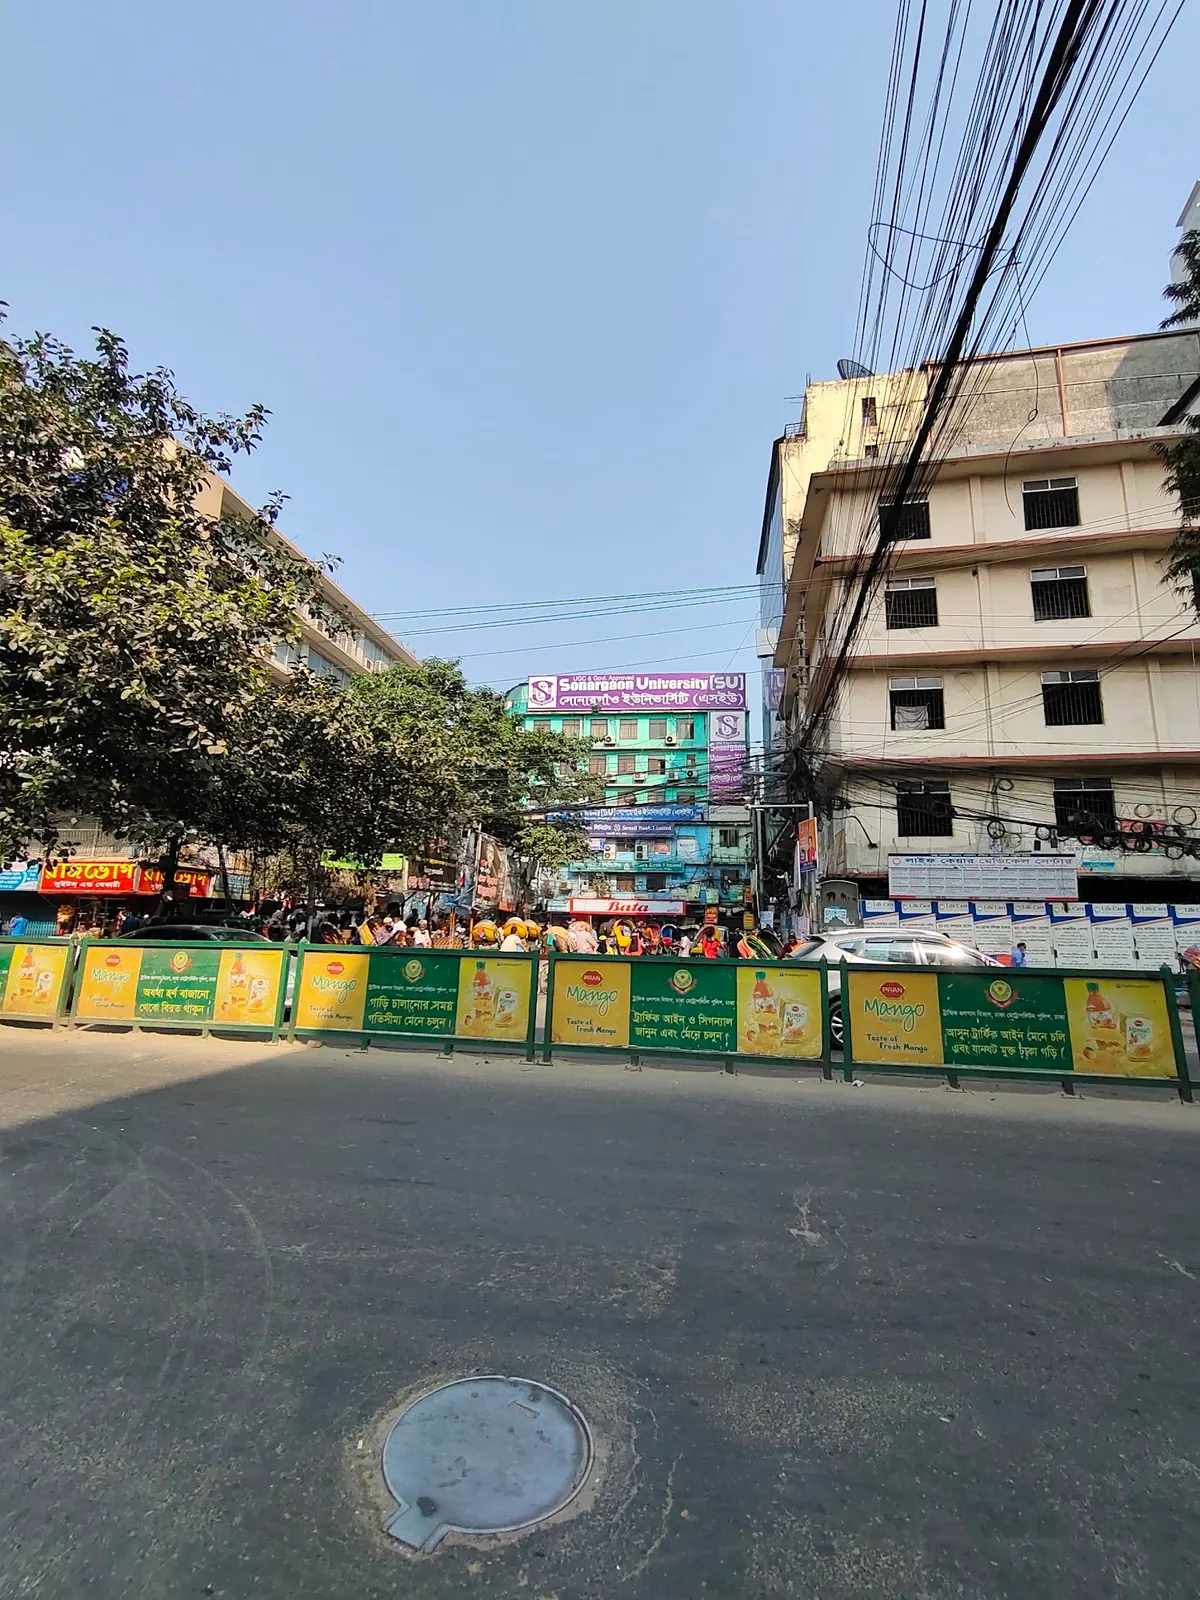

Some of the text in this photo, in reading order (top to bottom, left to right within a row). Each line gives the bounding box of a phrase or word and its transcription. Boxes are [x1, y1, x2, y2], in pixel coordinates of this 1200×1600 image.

[559, 678, 634, 692] Sonargaon
[636, 676, 709, 691] University
[609, 674, 635, 682] Approved
[559, 690, 743, 706] সোনারগাঁও ইউনিভার্সিটি (এসইউ)
[606, 901, 650, 912] Bata
[91, 967, 131, 993] Mango
[142, 988, 165, 998] অযথা
[179, 989, 210, 999] বাজানো
[312, 975, 357, 1004] Mango
[882, 986, 903, 994] PRAN
[140, 1003, 160, 1013] থেকে
[161, 1001, 182, 1013] বিরত
[183, 1004, 206, 1016] থাকুন
[369, 995, 454, 1011] গাড়ি চালানোর সময়
[567, 985, 619, 1016] Mango
[368, 1011, 402, 1025] গতিসীমা
[404, 1015, 425, 1026] মেনে
[426, 1017, 447, 1030] চলুন
[566, 1017, 584, 1025] Taste
[632, 1010, 734, 1027] ট্রাফিক আইন ও সিগন্যাল
[864, 998, 925, 1033] Mango
[576, 1025, 617, 1035] Fresh Mango
[634, 1027, 658, 1039] জানুন
[660, 1029, 678, 1039] এবং
[680, 1029, 701, 1040] মেনে
[702, 1031, 724, 1042] চলুন
[866, 1033, 888, 1041] Taste
[945, 1026, 1066, 1043] আসুন ট্রাফিক আইন মেনে চলি
[879, 1042, 928, 1053] Fresh Mango
[951, 1043, 970, 1054] এবং
[999, 1045, 1017, 1058] মুক্ত
[1018, 1045, 1038, 1058] ঢাকা
[1040, 1045, 1059, 1059] গড়ি
